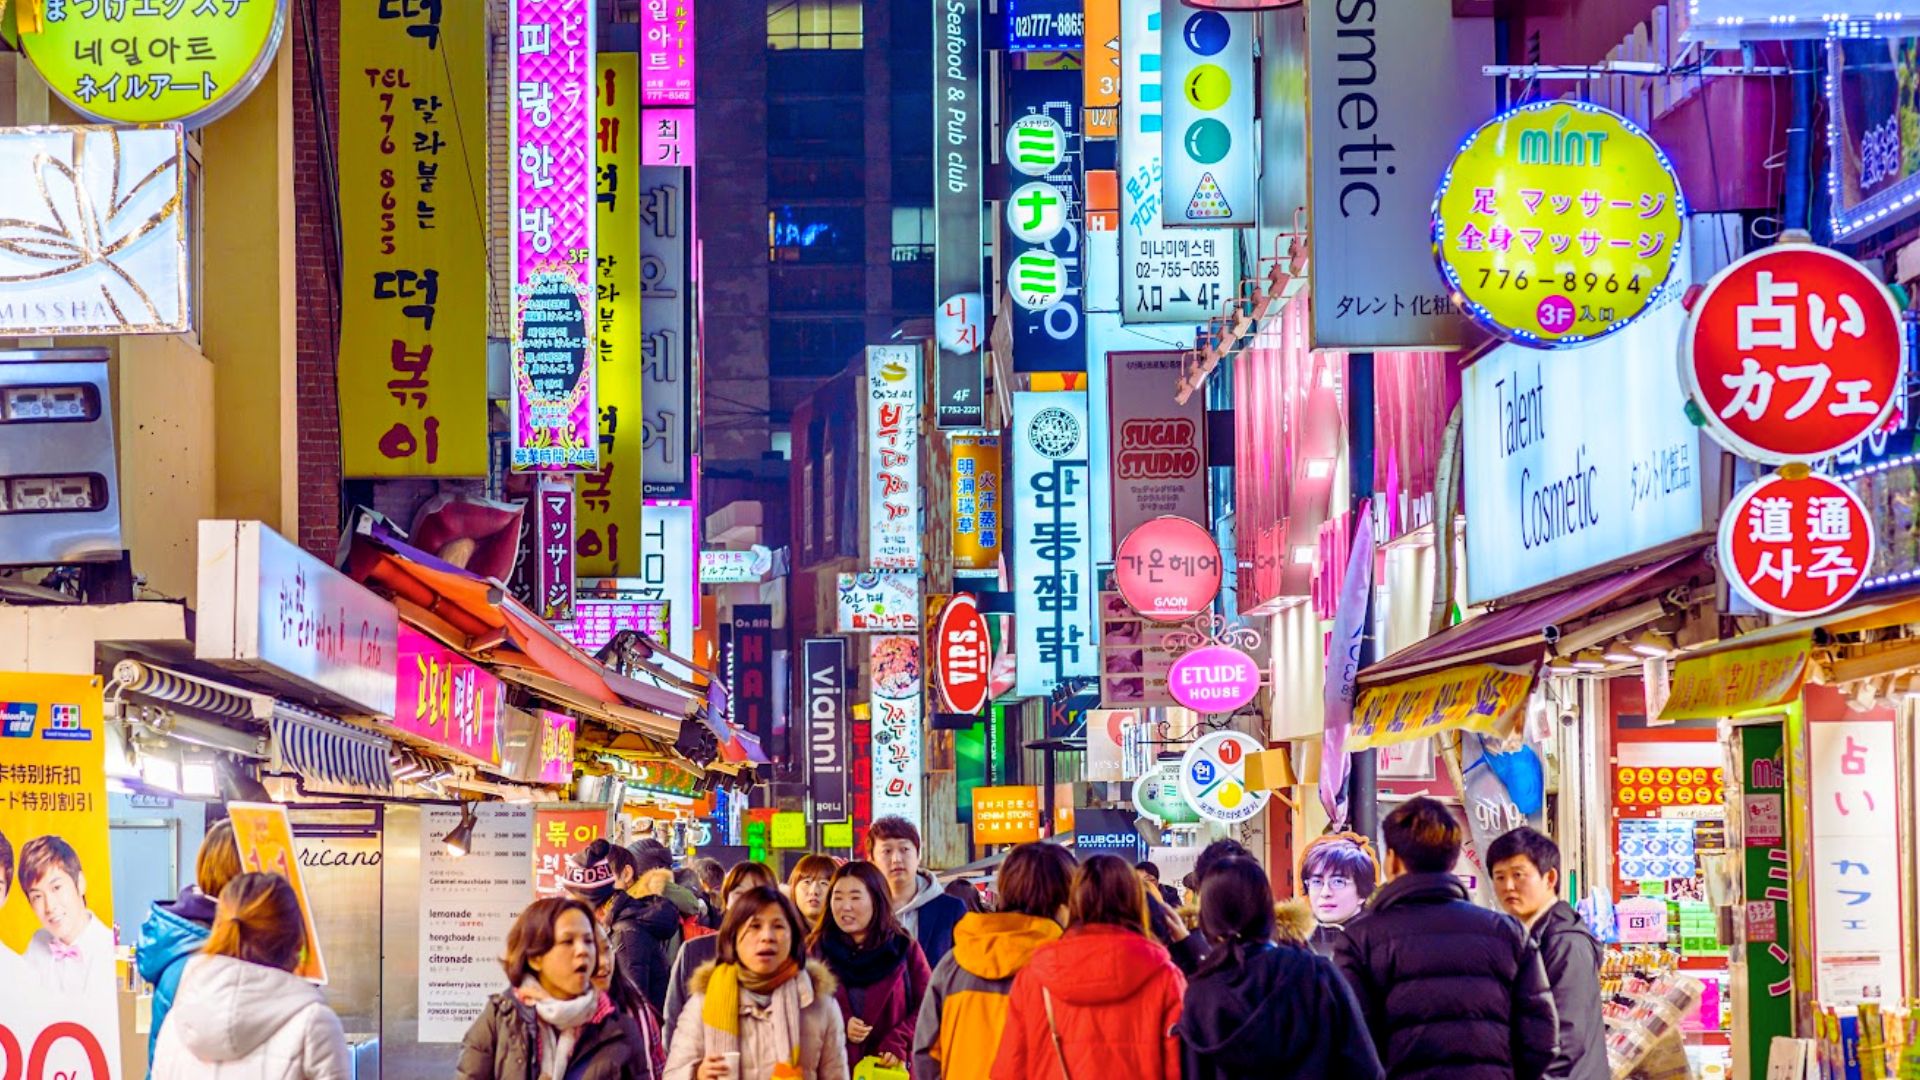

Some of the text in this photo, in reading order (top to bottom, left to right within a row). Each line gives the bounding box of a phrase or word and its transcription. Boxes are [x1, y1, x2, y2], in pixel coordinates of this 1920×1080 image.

[75, 36, 217, 65] 네일아트
[75, 72, 218, 103] ネイルアート
[365, 68, 411, 89] TEL
[947, 0, 968, 193] Seafood & Pub club
[518, 0, 555, 255] 피랑한방
[1472, 187, 1667, 219] 足 マッサージ
[1140, 239, 1215, 259] 미나미에스테
[1457, 223, 1666, 260] 全身マッサージ
[567, 248, 590, 265] 3F
[1135, 260, 1220, 279] 02-755-0555
[1477, 268, 1642, 295] 776-8964
[1137, 282, 1220, 312] 入口 4F
[1336, 294, 1465, 319] タレント化粧
[1736, 270, 1867, 351] 占い
[1539, 308, 1574, 326] 3F
[374, 268, 440, 464] 떡볶이
[953, 389, 970, 402] 4F
[1720, 357, 1881, 421] カフェ
[1495, 360, 1546, 460] Talent
[1124, 422, 1193, 448] SUGAR
[1119, 451, 1197, 476] STUDIO
[1520, 443, 1600, 551] Cosmetic
[547, 497, 568, 606] マッサージ
[1121, 548, 1218, 583] 가온헤어
[1748, 546, 1859, 600] 사주
[1181, 664, 1247, 685] ETUDE
[1189, 686, 1241, 700] HOUSE
[812, 665, 842, 773] vianni
[537, 821, 598, 848] 볶이
[429, 909, 472, 918] lemonade
[429, 954, 473, 963] citronade
